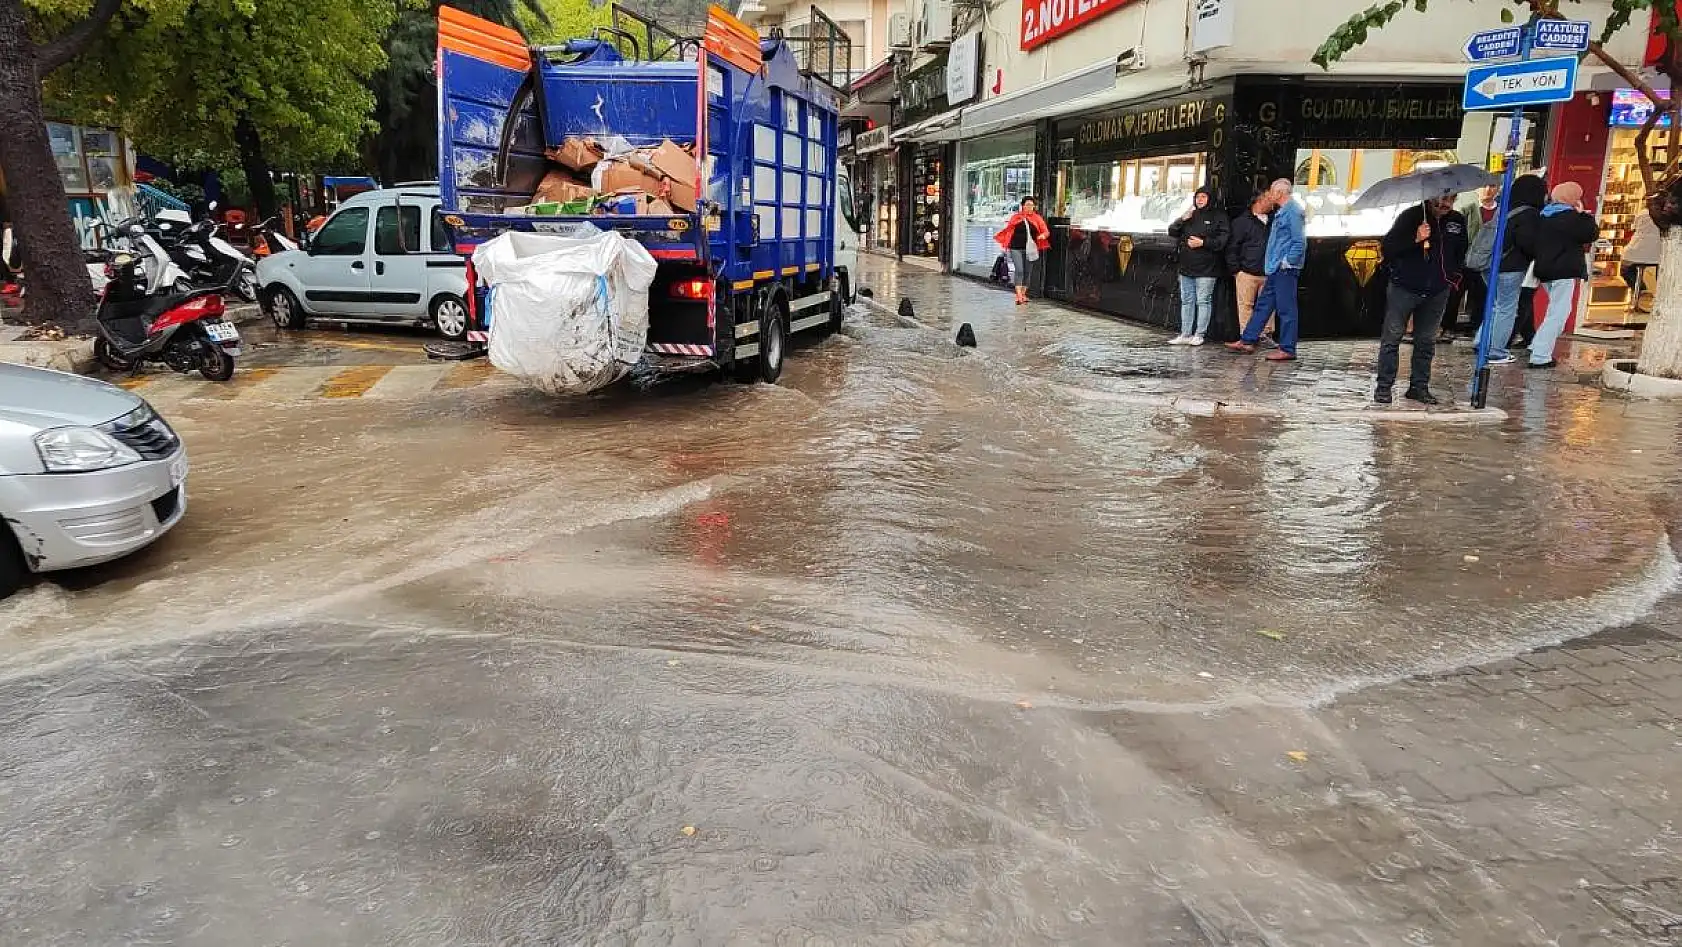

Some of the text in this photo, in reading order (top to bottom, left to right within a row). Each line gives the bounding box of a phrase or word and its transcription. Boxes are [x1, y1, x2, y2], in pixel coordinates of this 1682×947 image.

[1502, 73, 1557, 89] TEK YÖN
[1301, 97, 1376, 119] GOLDMAX
[1079, 100, 1206, 145] GOLDMAX JEWELLERY
